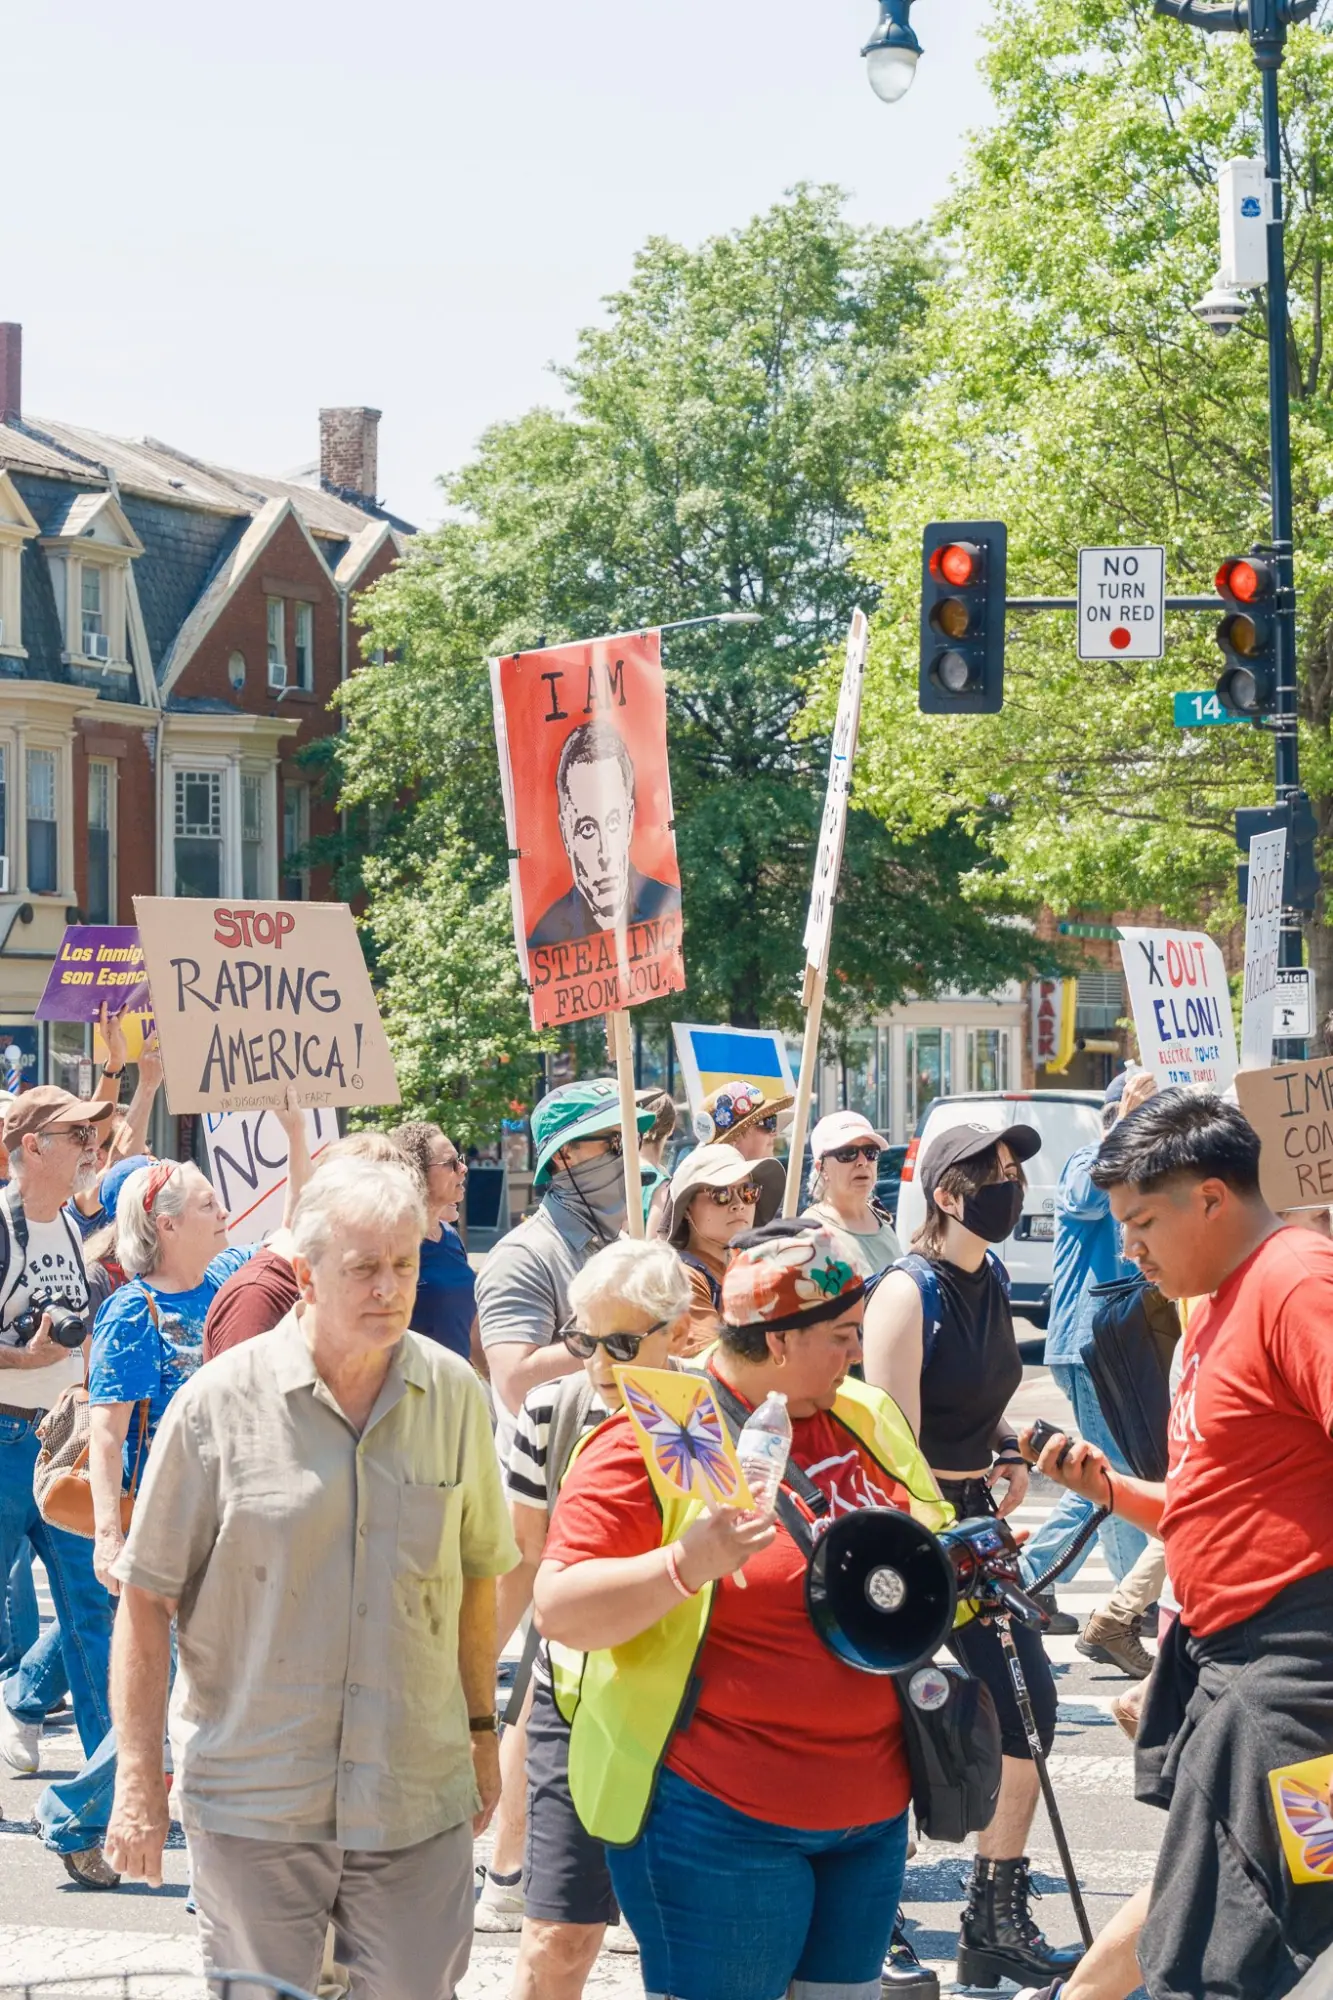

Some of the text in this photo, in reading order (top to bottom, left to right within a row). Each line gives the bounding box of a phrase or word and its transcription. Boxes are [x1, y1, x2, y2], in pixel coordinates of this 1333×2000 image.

[1102, 556, 1139, 576] NO
[1097, 583, 1146, 599] TURN
[1086, 606, 1155, 622] ON RED
[540, 659, 627, 722] I AM
[1190, 694, 1222, 720] 14
[1250, 867, 1282, 920] DOGE
[213, 908, 296, 949] STOP
[60, 943, 144, 965] Los inmig
[533, 917, 677, 986] STEAING
[1138, 939, 1209, 988] X-OUT
[60, 971, 94, 986] son
[170, 958, 342, 1015] RAPING
[555, 962, 667, 1018] FROM YOU.
[1276, 973, 1308, 983] OTICE
[1152, 997, 1223, 1042] ELON!
[199, 1023, 364, 1093] AMERICA!
[1158, 1045, 1220, 1065] ELECTRIC POWER
[1168, 1070, 1178, 1083] TO
[1179, 1071, 1191, 1083] THE
[235, 1094, 281, 1107] DISGUSTING
[304, 1092, 332, 1104] FART
[213, 1109, 322, 1212] NO
[40, 1274, 58, 1282] HAVE
